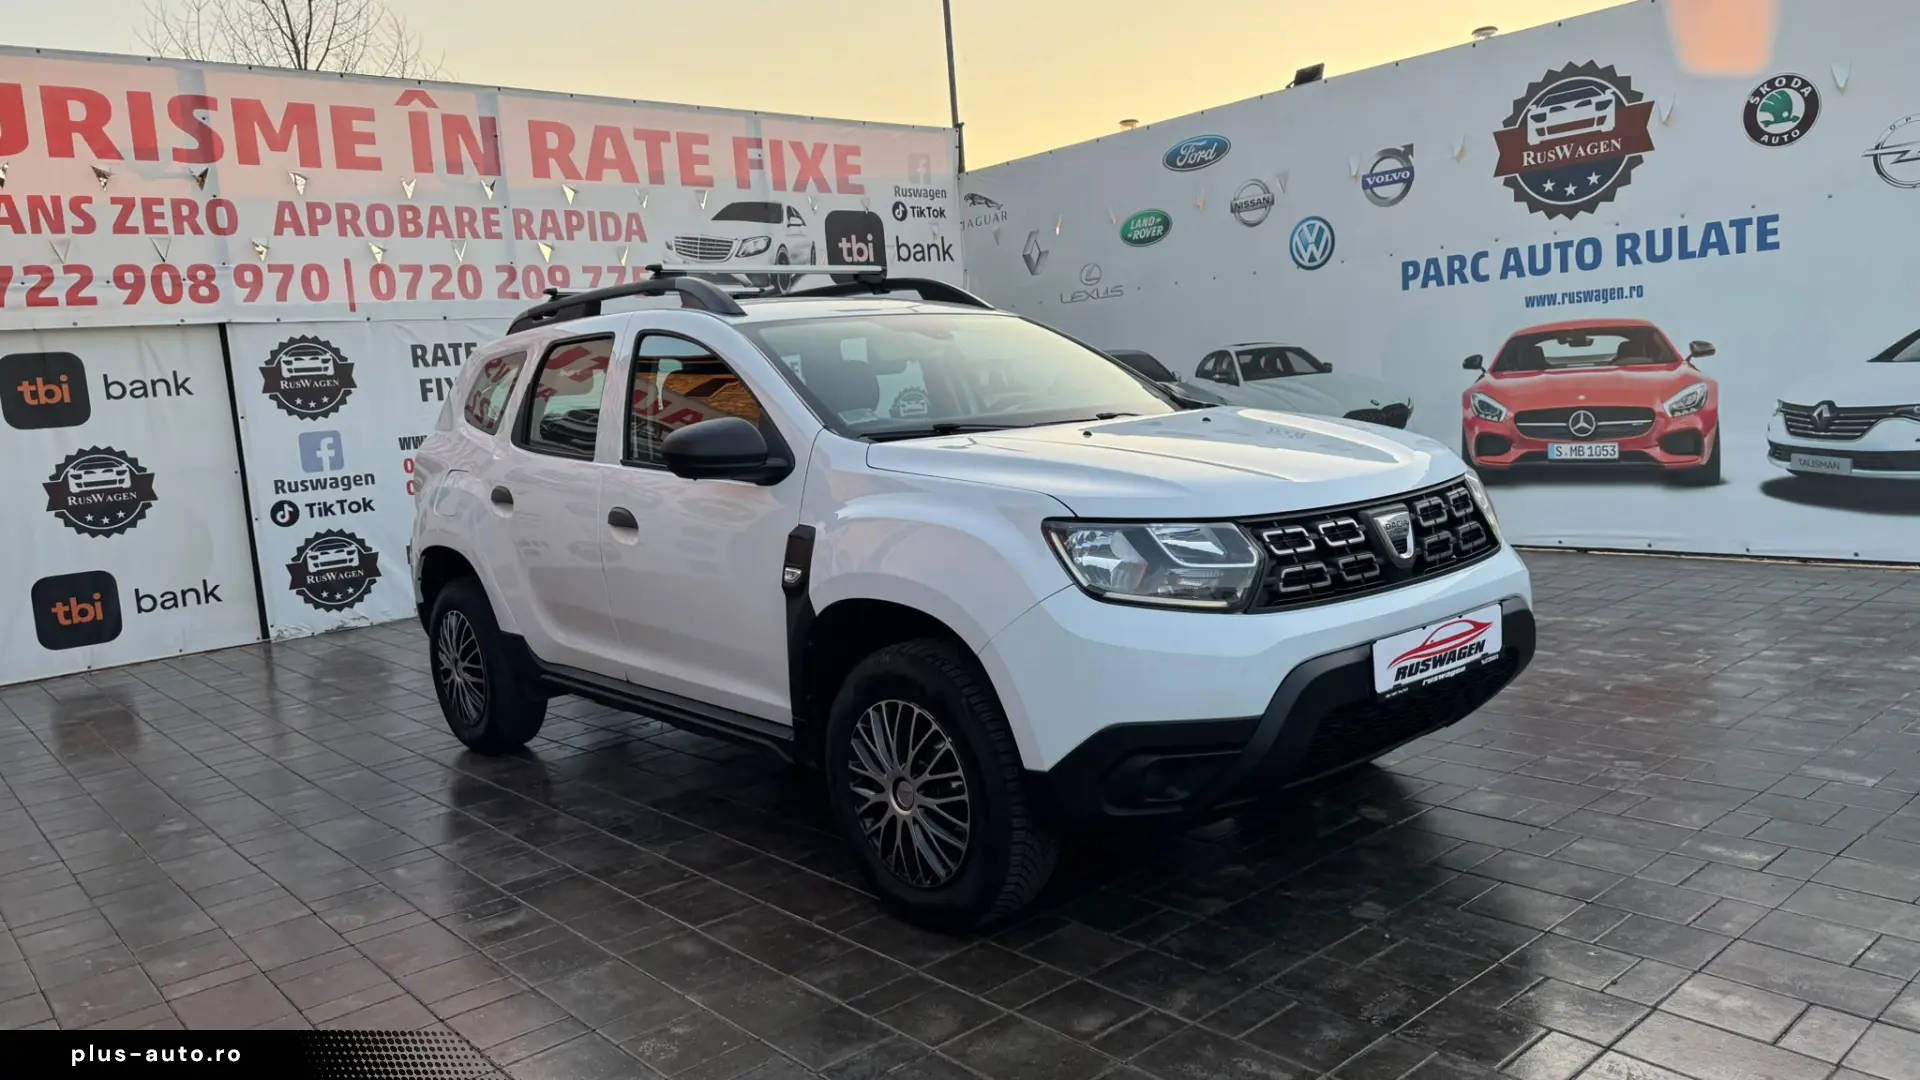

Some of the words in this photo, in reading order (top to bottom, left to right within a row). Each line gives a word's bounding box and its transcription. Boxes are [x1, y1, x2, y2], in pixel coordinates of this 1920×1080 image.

[394, 89, 501, 177] ÎN
[527, 119, 714, 188] RATE
[731, 136, 865, 195] FIXE
[1760, 129, 1800, 144] AUTO
[1176, 140, 1218, 167] Ford
[1366, 170, 1411, 186] VOLVO
[894, 185, 947, 201] Ruswagen
[1234, 195, 1271, 211] NISSAN
[110, 196, 239, 236] ZERO
[273, 200, 502, 240] APROBARE
[512, 208, 648, 243] RAPIDA
[910, 205, 947, 219] TikTok
[960, 210, 1008, 231] JAGUAR
[838, 233, 875, 262] tbi
[896, 235, 955, 262] bank
[1401, 250, 1490, 291] PARC
[1500, 236, 1601, 280] AUTO
[1615, 214, 1780, 267] RULATE
[112, 263, 220, 306] 908
[233, 262, 330, 302] 970
[369, 263, 483, 301] 0720
[495, 264, 571, 300] 209
[1060, 285, 1124, 304] LEXUS
[1524, 284, 1644, 308] www.ruswagen.ro
[17, 374, 72, 406] tbi
[103, 370, 194, 401] bank
[419, 377, 454, 402] FI
[1587, 445, 1617, 457] 1053
[1798, 458, 1840, 470] TALISMAN
[273, 473, 376, 494] Ruswagen
[305, 497, 376, 518] TikTok
[51, 592, 104, 626] tbi
[134, 579, 223, 614] bank
[1394, 639, 1486, 682] RUSWAGEN
